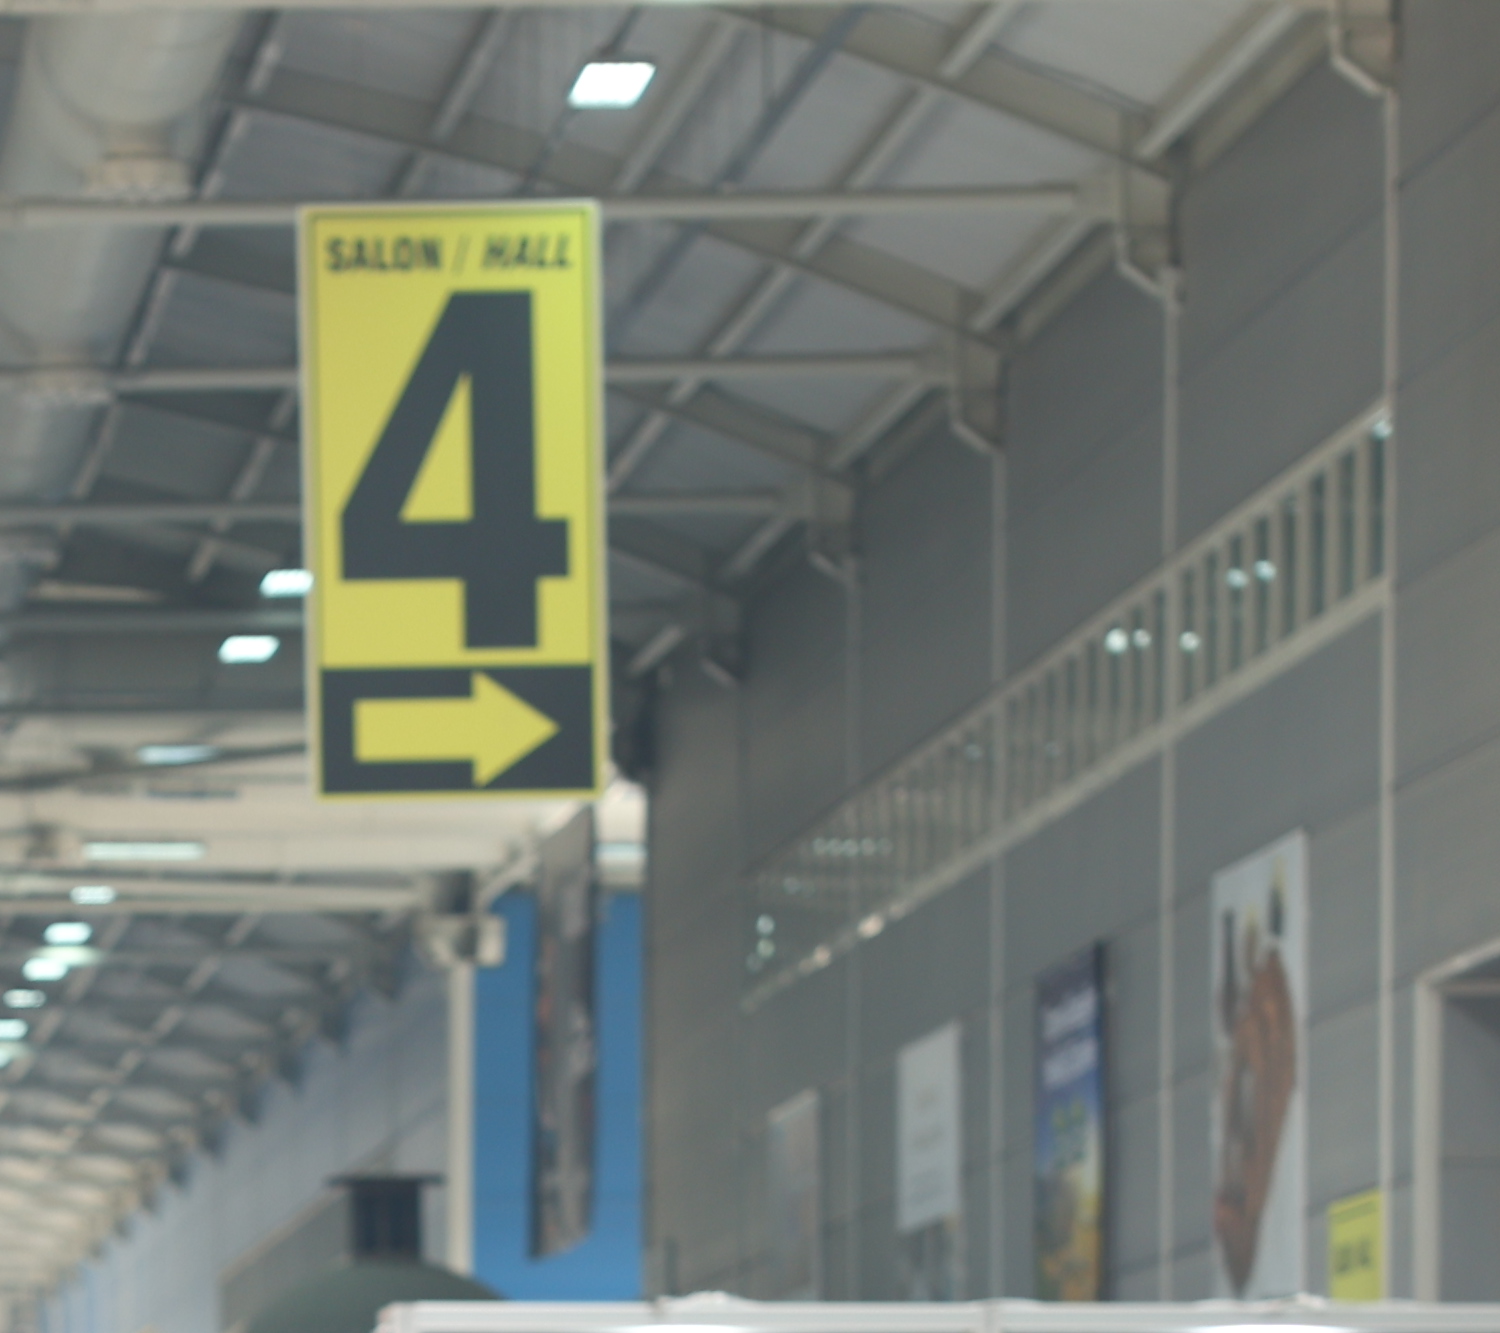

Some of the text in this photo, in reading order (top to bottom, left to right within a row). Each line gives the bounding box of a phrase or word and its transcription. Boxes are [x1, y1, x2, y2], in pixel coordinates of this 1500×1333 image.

[325, 235, 443, 272] SALON
[481, 233, 574, 270] HALL
[337, 289, 573, 651] 4
